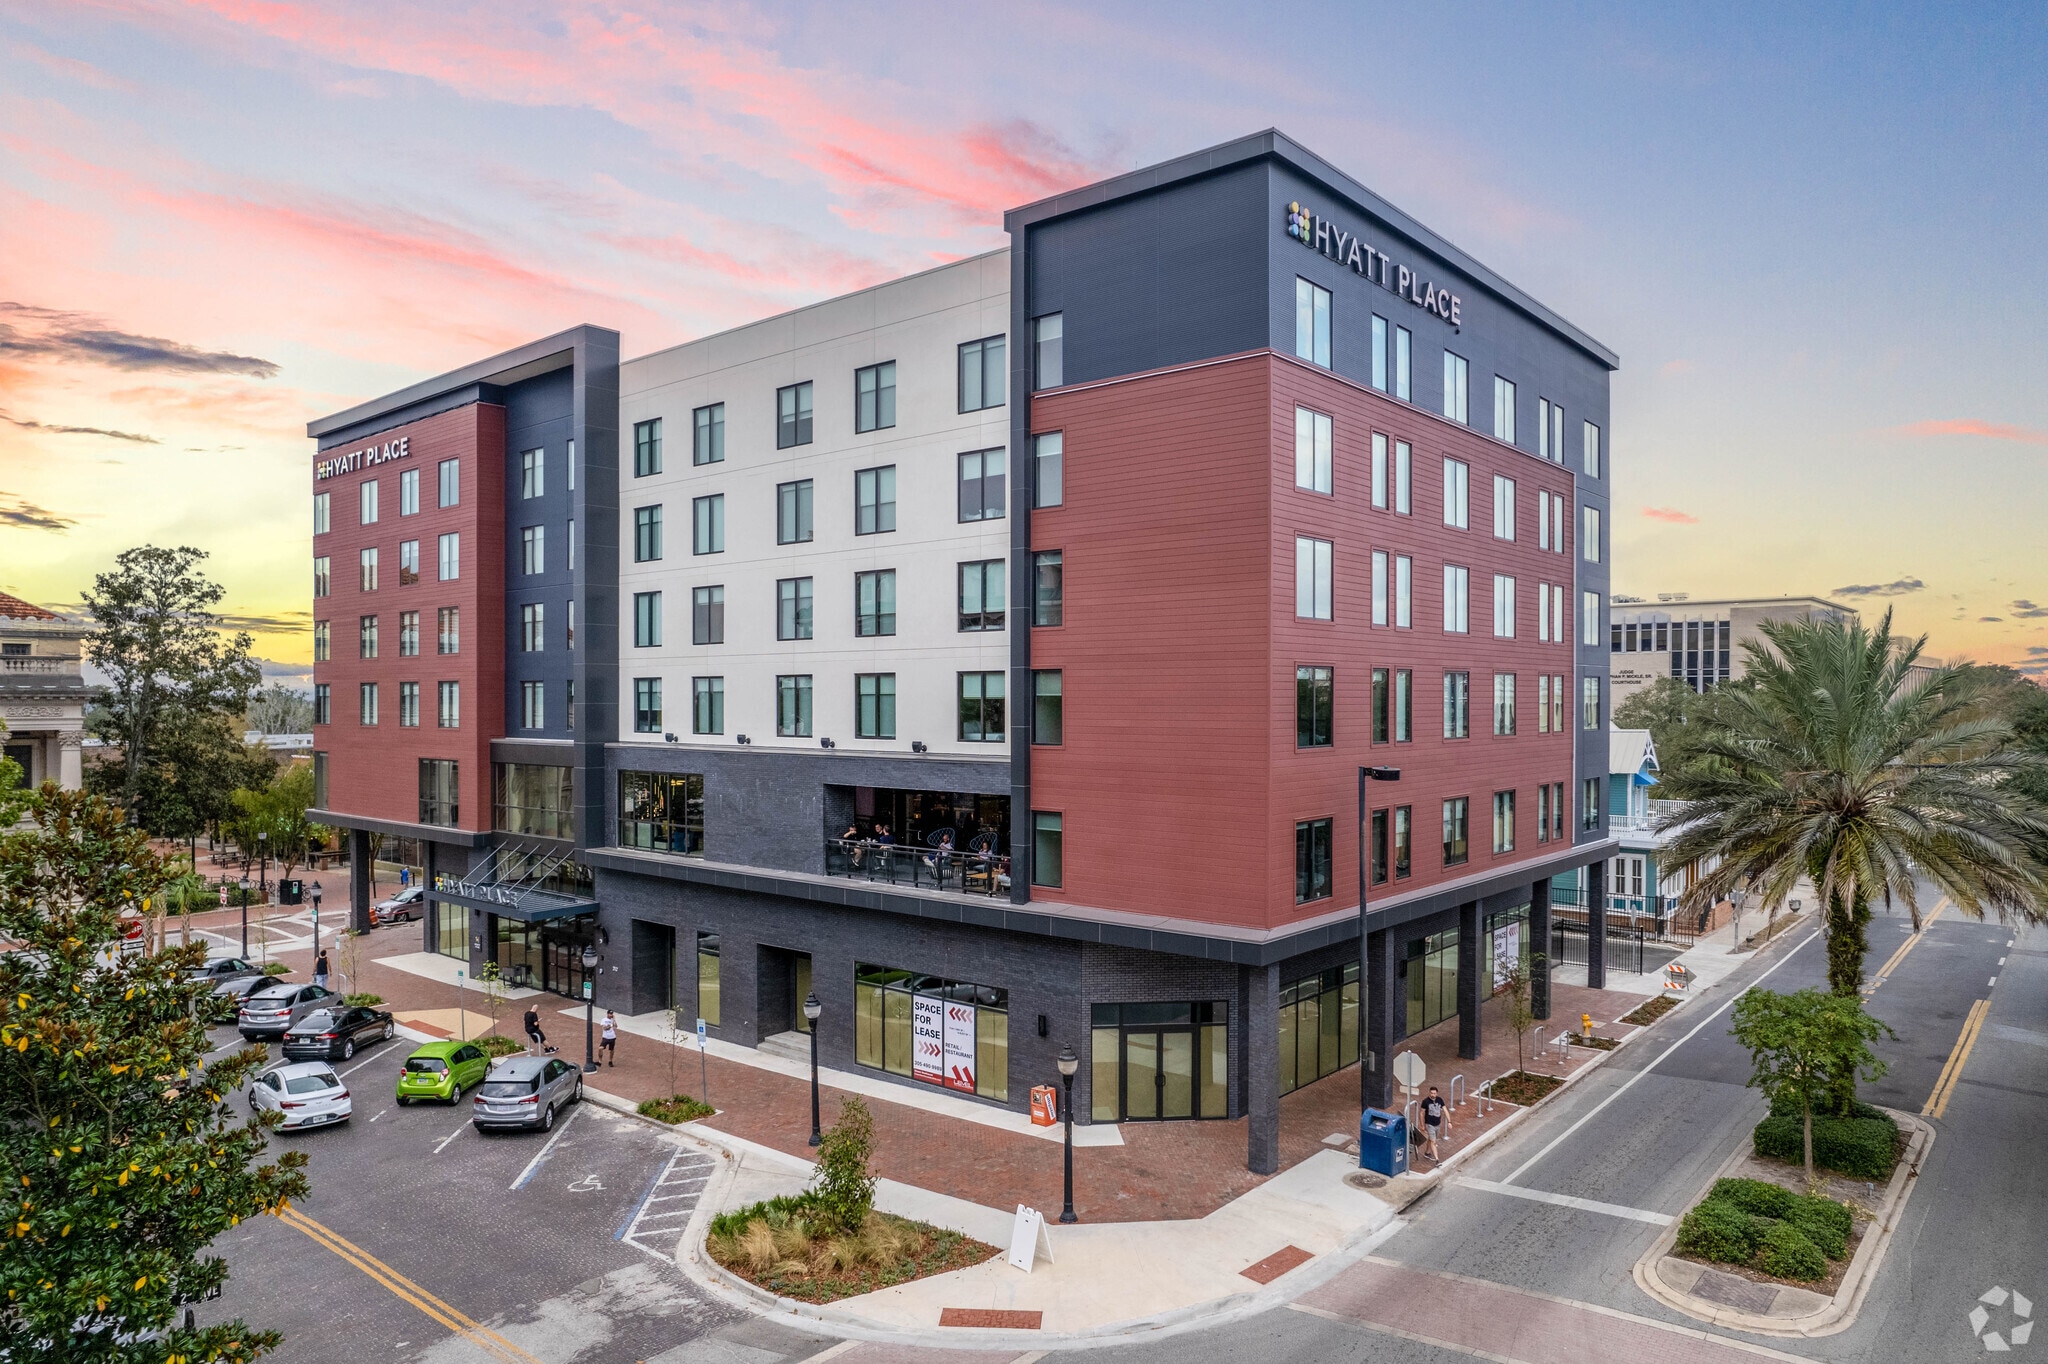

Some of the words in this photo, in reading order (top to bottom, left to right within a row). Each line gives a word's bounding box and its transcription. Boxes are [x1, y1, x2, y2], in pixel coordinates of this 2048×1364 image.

[1313, 215, 1389, 285] HYATT
[1398, 264, 1461, 326] PLACE
[326, 451, 363, 478] HYATT
[366, 437, 408, 467] PLACE
[480, 886, 518, 906] PLACE
[914, 1001, 941, 1015] SPACE
[914, 1013, 931, 1025] FOR
[914, 1026, 941, 1040] LEASE
[945, 1042, 960, 1051] RETAIL
[945, 1048, 973, 1059] RESTAURANT
